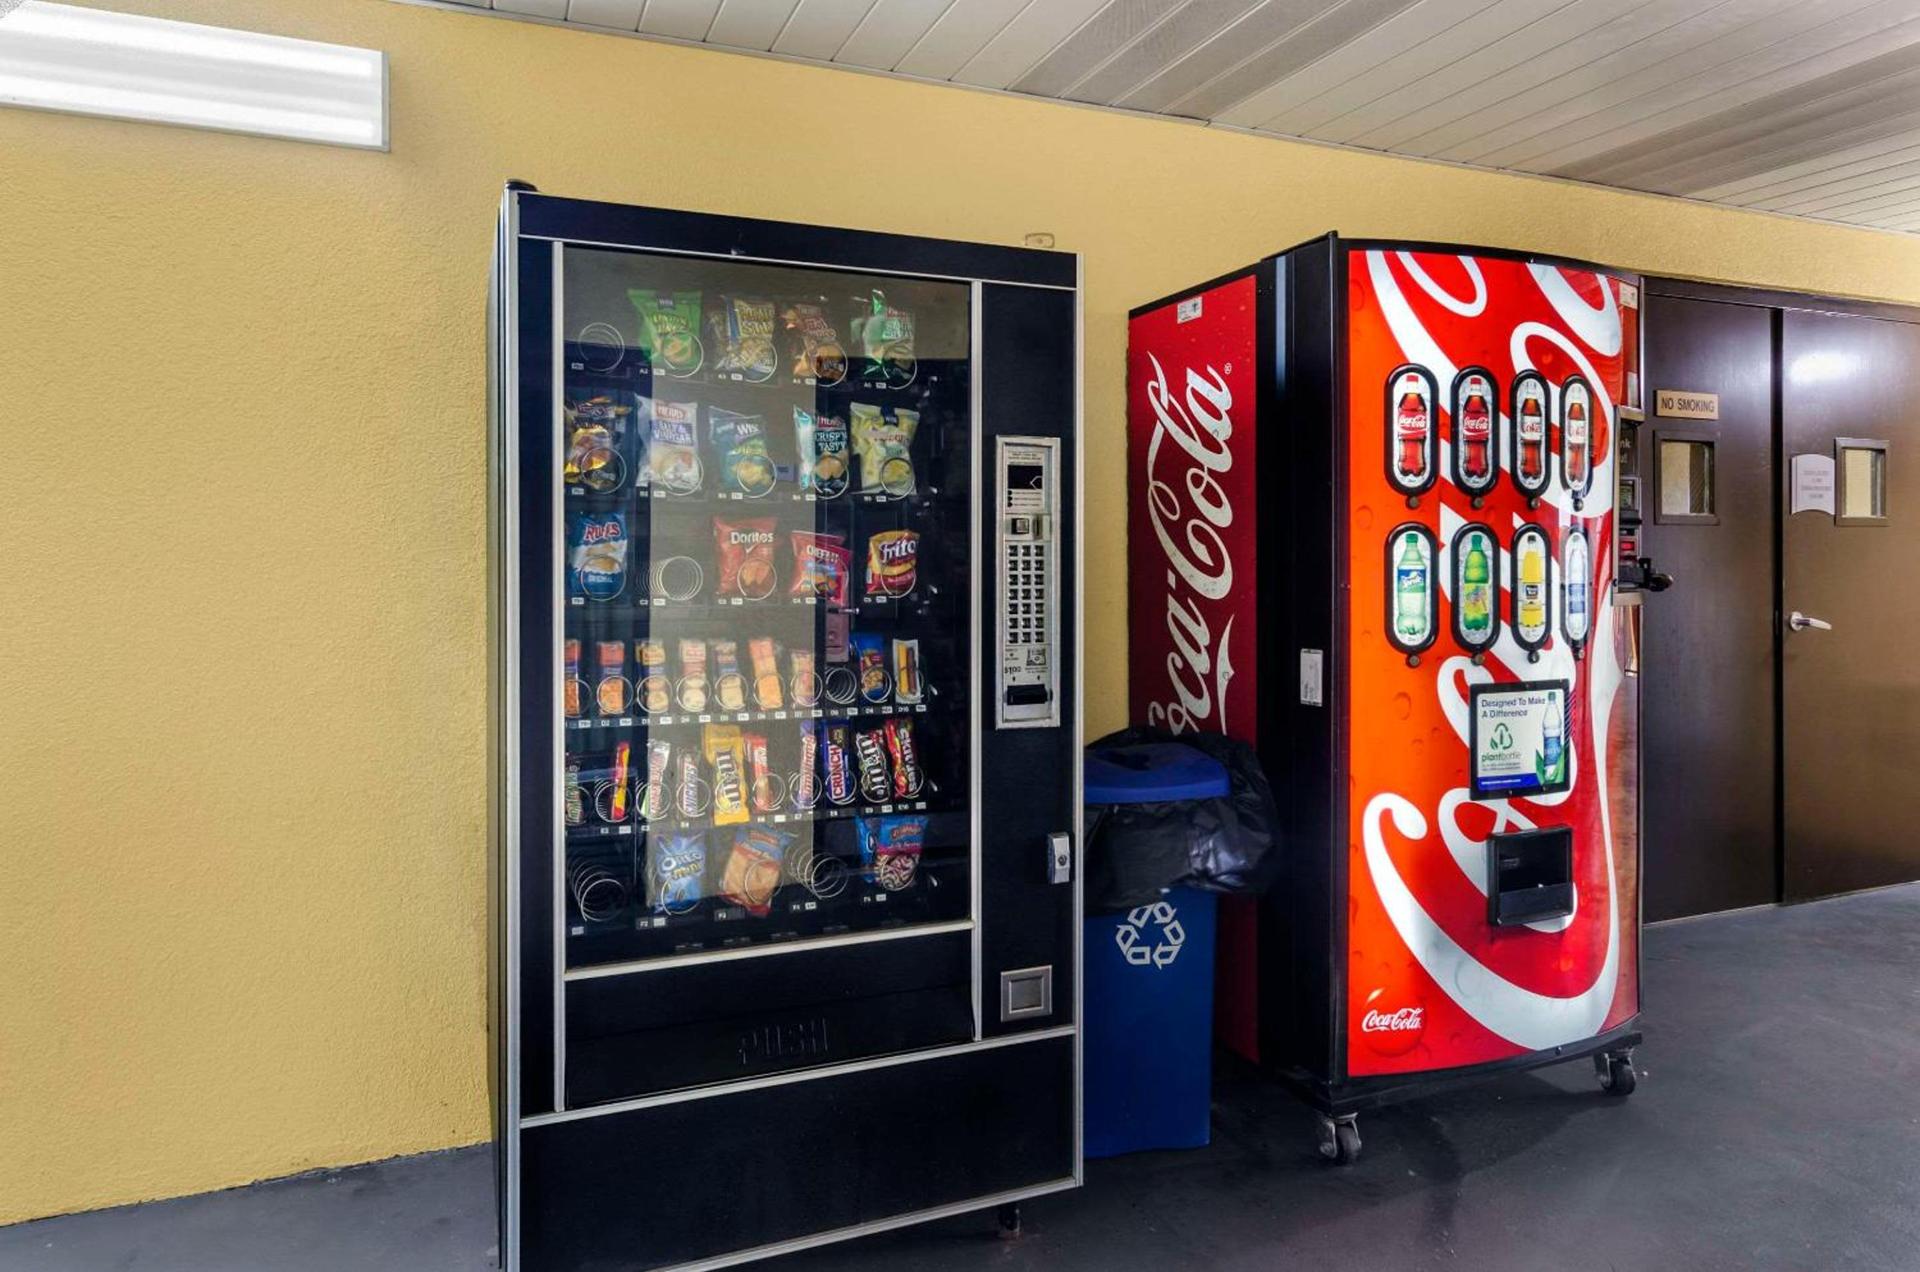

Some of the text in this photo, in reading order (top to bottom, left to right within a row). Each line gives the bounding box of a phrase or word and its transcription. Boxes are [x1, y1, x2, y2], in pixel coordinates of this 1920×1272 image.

[1661, 397, 1715, 413] NO SMOKING
[1399, 414, 1427, 428] Coca-Cola
[1464, 416, 1488, 430] Coca-Cola
[731, 531, 775, 546] Doritos
[879, 540, 916, 563] Frito
[1481, 696, 1546, 708] Designed To Make
[1482, 709, 1527, 718] A Difference
[830, 745, 843, 797] CRUNCH
[1362, 1007, 1424, 1033] Coca-Cola
